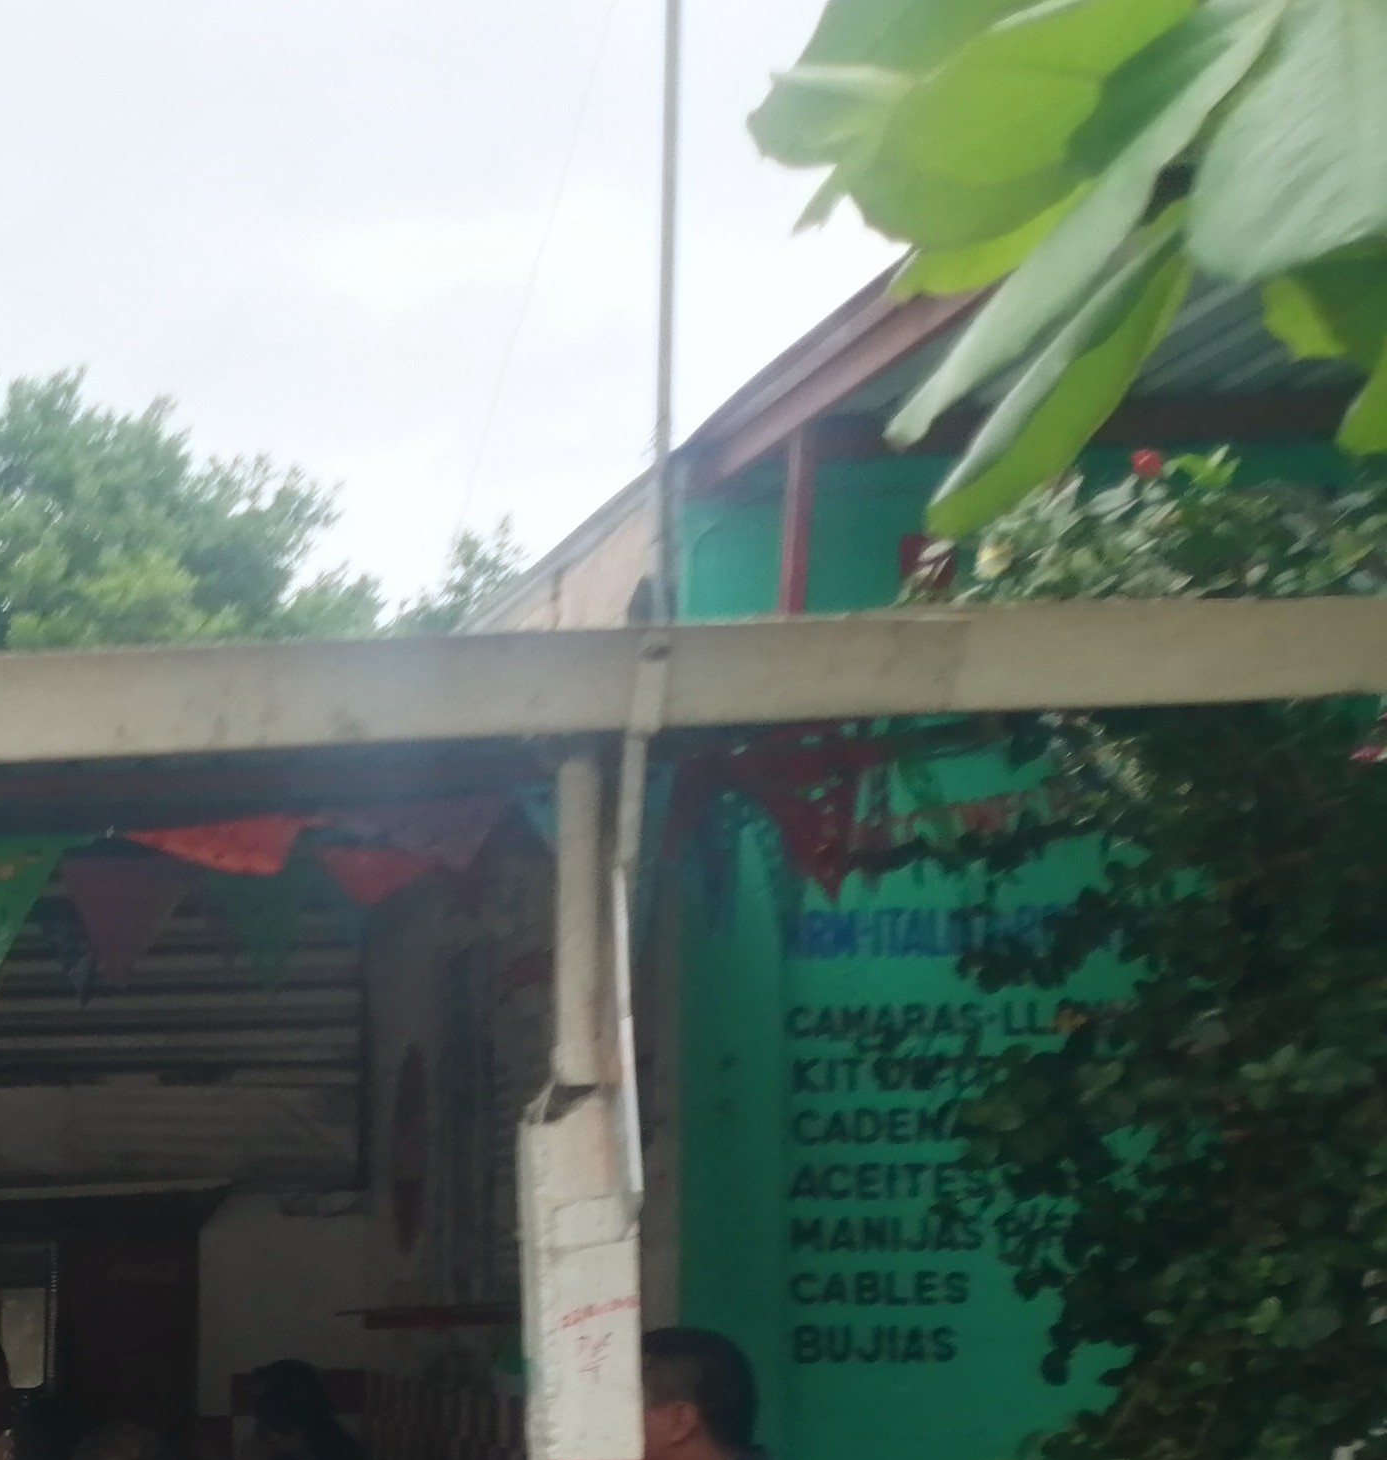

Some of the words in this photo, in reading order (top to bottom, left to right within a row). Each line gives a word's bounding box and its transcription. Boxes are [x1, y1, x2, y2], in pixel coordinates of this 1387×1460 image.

[791, 1056, 865, 1093] KIT
[791, 1107, 963, 1145] CADEN
[788, 1214, 983, 1252] MANIJAS
[788, 1270, 971, 1308] CABLES
[792, 1325, 958, 1365] BUJIAS
